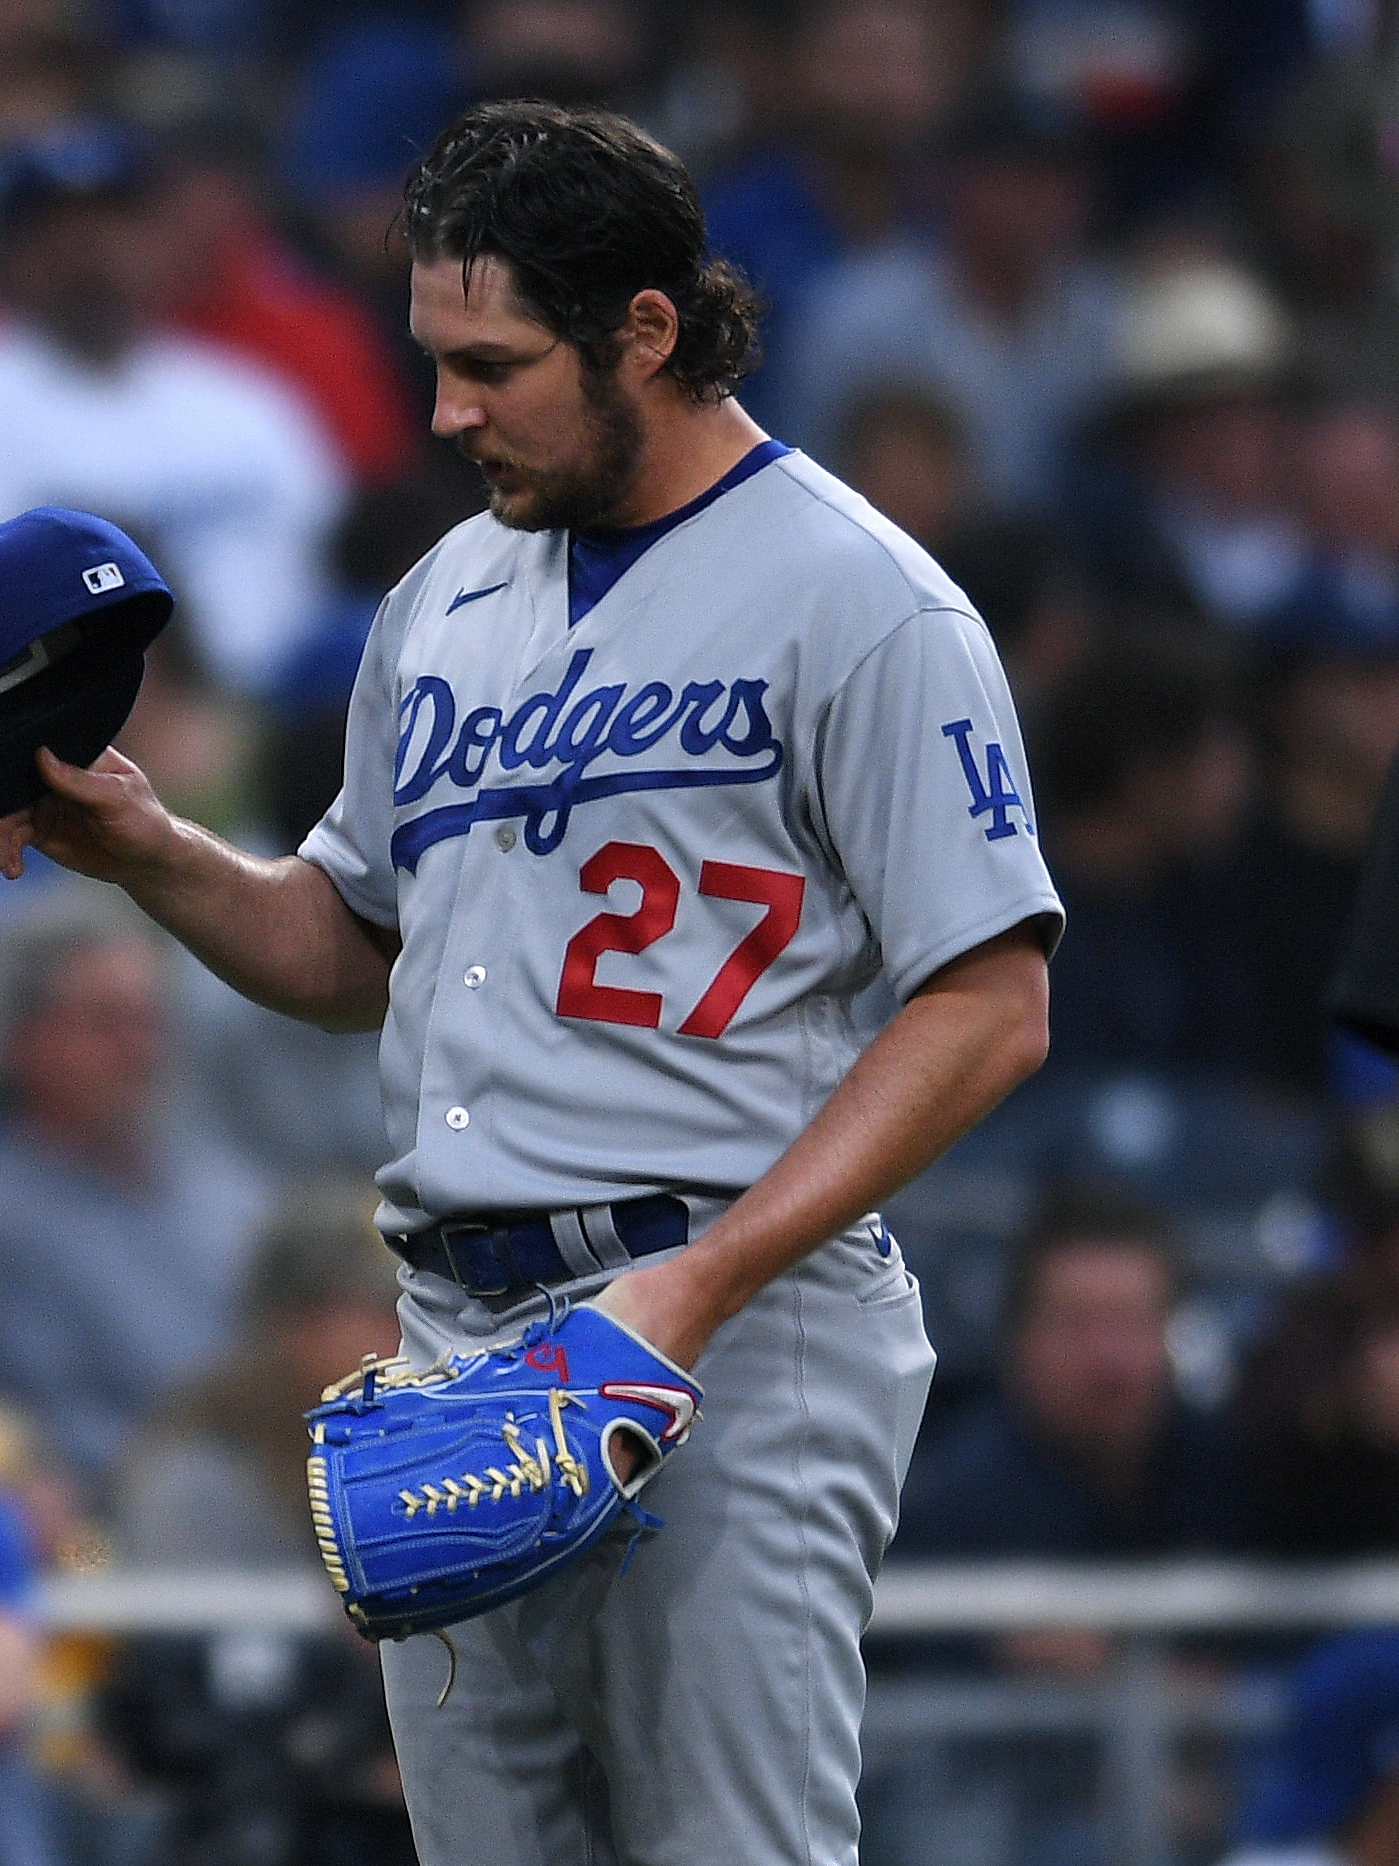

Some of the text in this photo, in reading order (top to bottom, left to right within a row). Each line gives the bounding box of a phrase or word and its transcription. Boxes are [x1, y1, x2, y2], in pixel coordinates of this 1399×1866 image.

[392, 647, 782, 864] Dodgers
[941, 718, 1034, 841] LA
[556, 840, 805, 1039] 27
